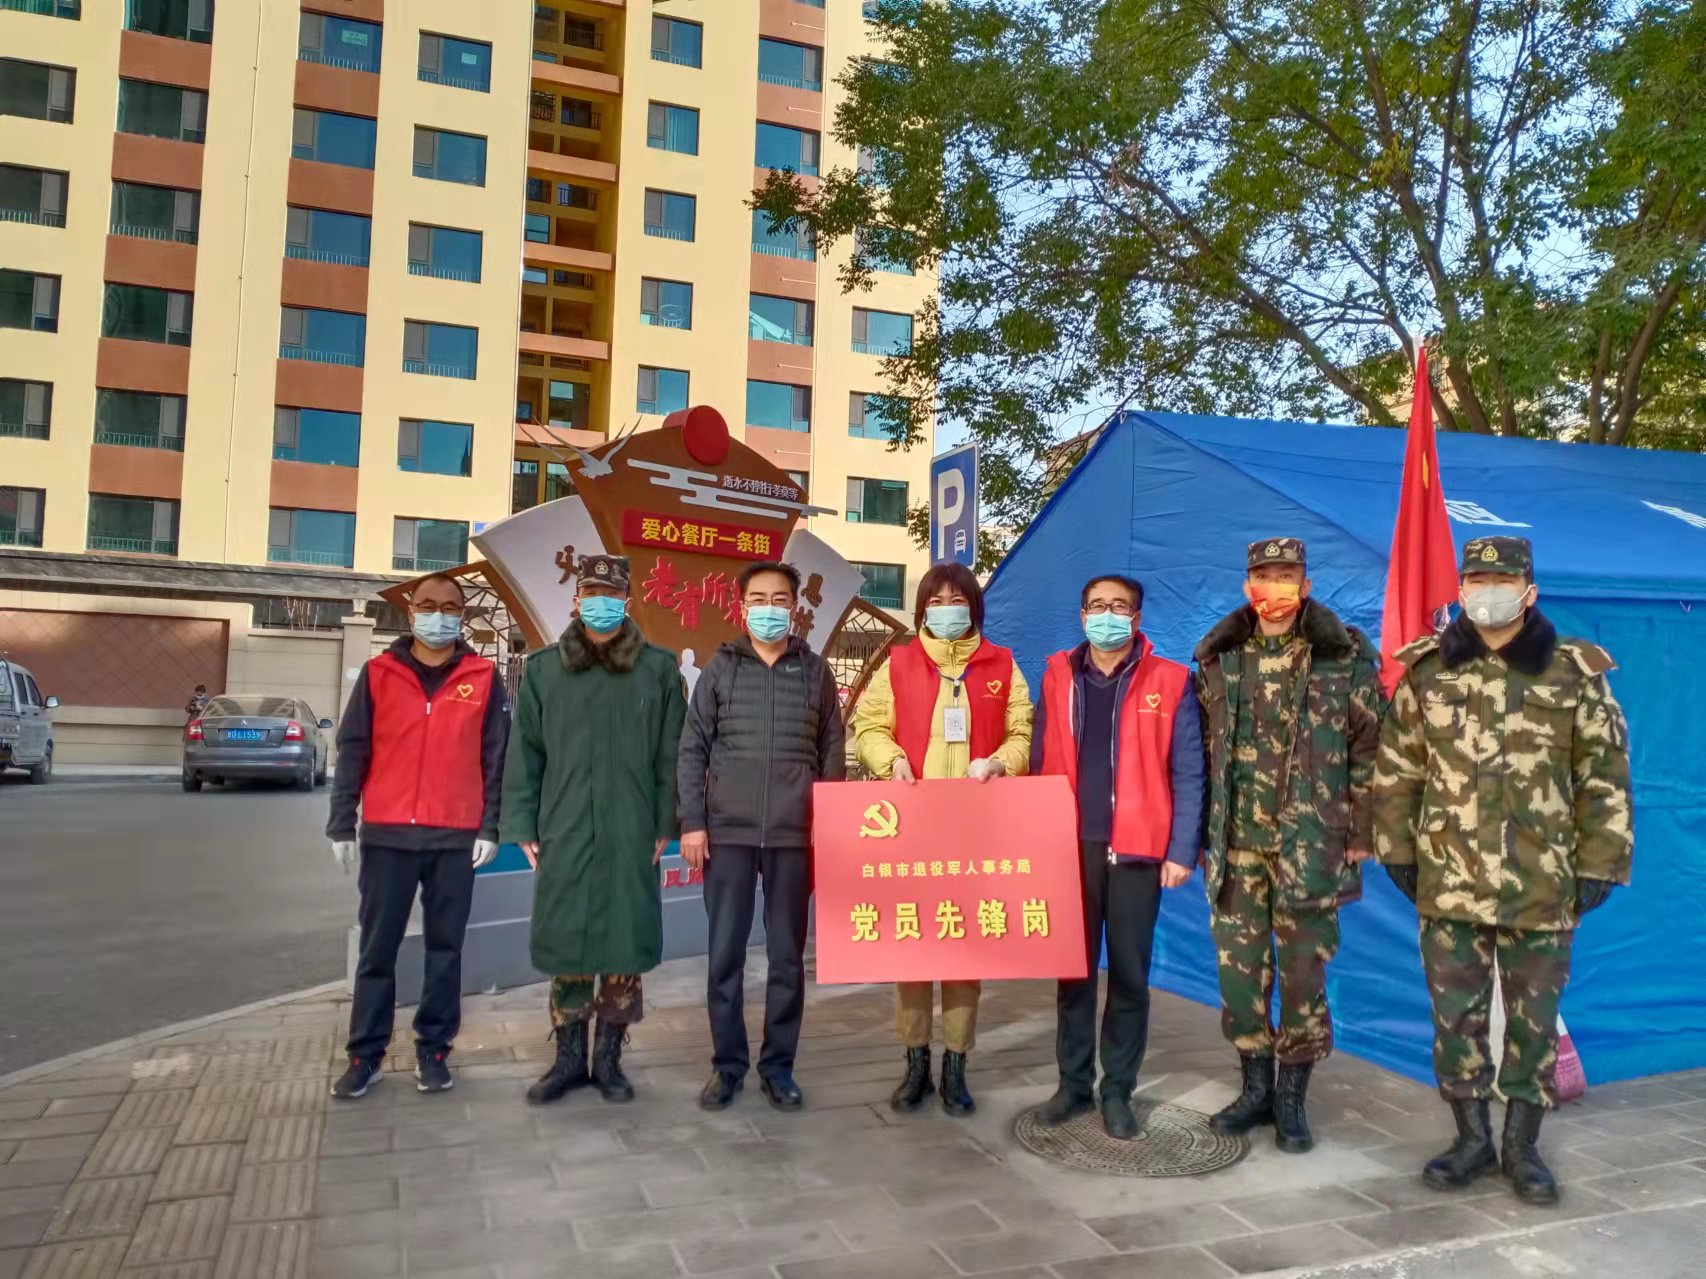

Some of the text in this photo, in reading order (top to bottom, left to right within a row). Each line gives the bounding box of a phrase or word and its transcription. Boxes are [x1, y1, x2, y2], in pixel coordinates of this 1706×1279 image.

[937, 468, 965, 560] P
[641, 517, 771, 556] 爱心餐厅一条街
[861, 858, 1032, 879] 白银市退役军人事务局
[850, 898, 1049, 942] 党员先锋岗
